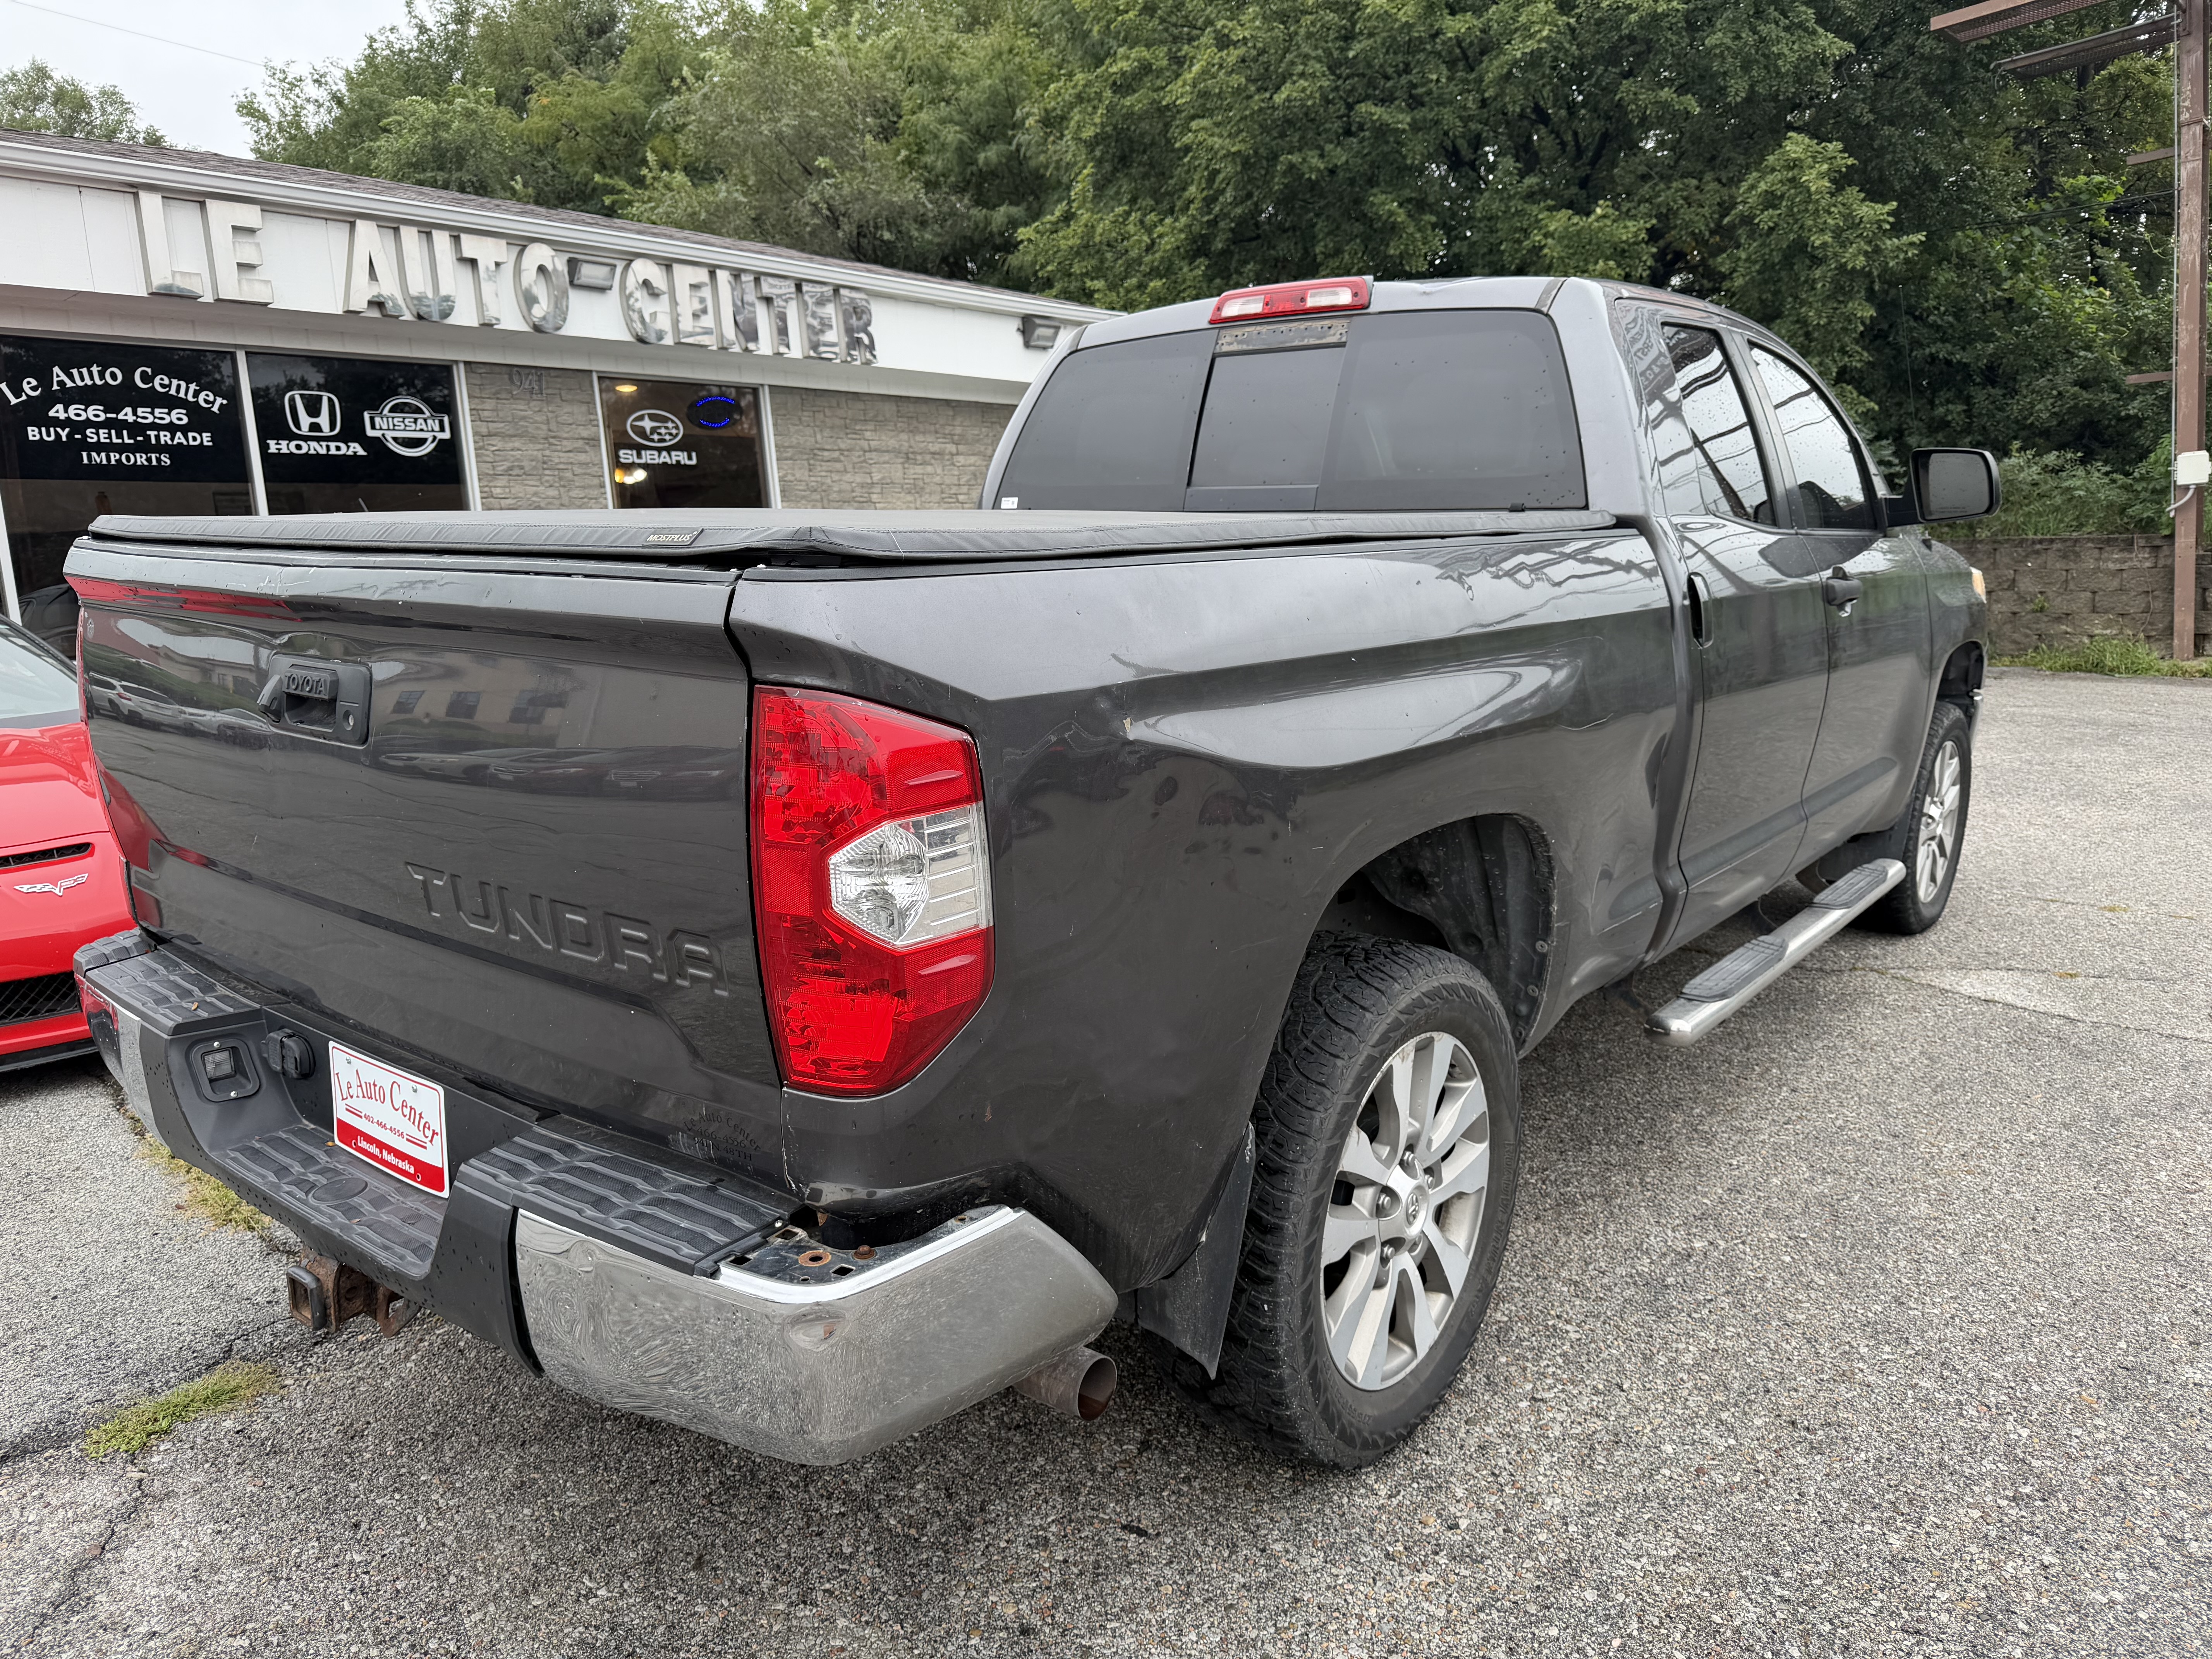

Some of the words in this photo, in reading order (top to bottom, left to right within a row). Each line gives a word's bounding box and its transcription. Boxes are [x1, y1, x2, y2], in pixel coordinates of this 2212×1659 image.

[137, 190, 273, 305] LE
[343, 219, 570, 334] AUTO
[620, 257, 879, 366] CENTER
[0, 378, 41, 405] Le
[52, 364, 122, 390] Auto
[134, 367, 228, 414] Center
[48, 404, 189, 425] 466-4556
[374, 416, 440, 431] NISSAN
[27, 426, 70, 441] BUY
[86, 428, 134, 443] SELL
[146, 431, 213, 446] TRADE
[81, 452, 171, 465] IMPORTS
[266, 440, 368, 455] HONDA
[618, 449, 697, 465] SUBARU
[285, 674, 327, 696] TOYOTA
[405, 861, 729, 996] TUNDRA
[335, 1072, 353, 1101] Le
[356, 1068, 386, 1104] Auto
[390, 1080, 439, 1146] Center
[363, 1113, 405, 1139] 402-466-4556
[684, 1117, 696, 1132] Le
[699, 1111, 722, 1123] Auto
[726, 1117, 761, 1151] Center
[696, 1126, 746, 1148] 466-4556
[357, 1135, 381, 1159] Lincoln,
[382, 1150, 414, 1174] Nebraska
[723, 1145, 752, 1161] 48TH
